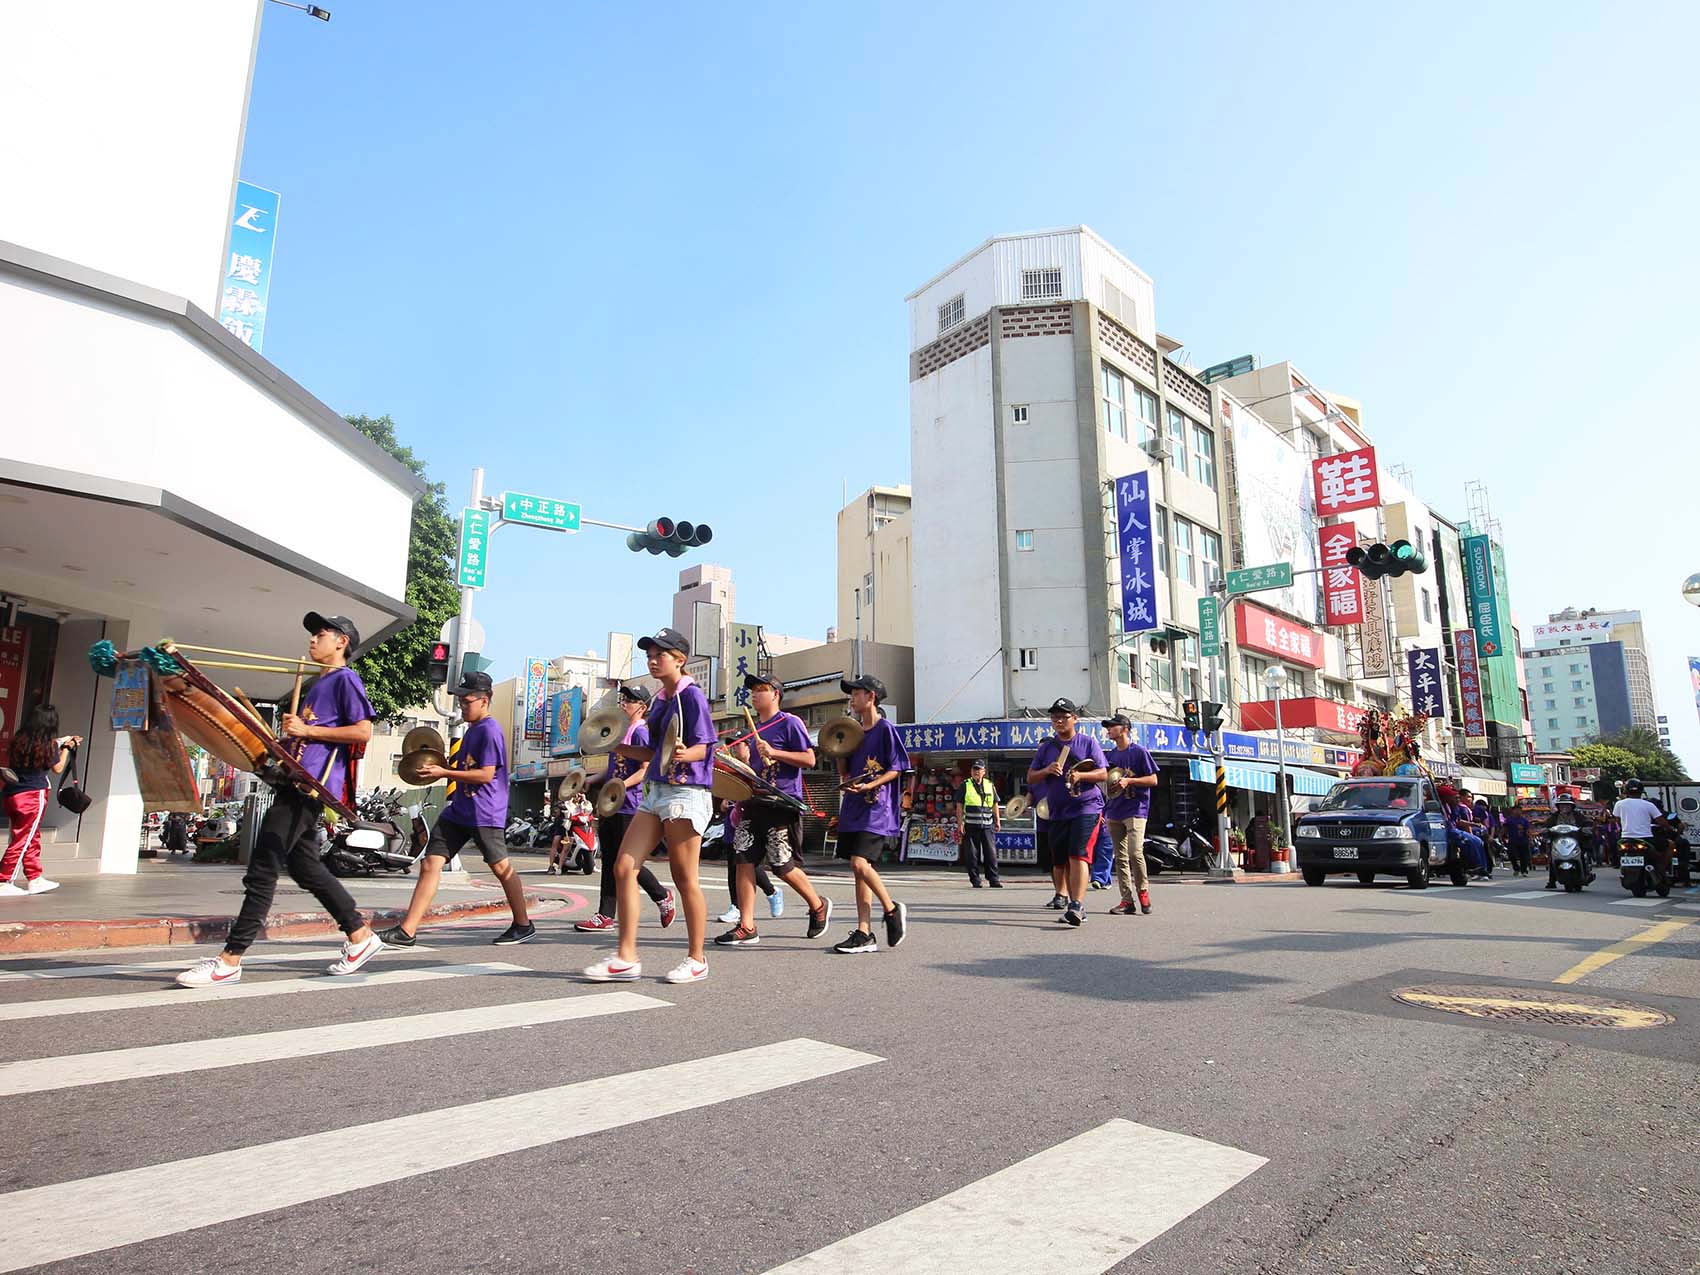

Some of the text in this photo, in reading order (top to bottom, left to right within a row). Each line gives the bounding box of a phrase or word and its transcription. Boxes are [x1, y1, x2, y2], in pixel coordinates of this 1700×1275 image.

[1317, 454, 1375, 508] 鞋
[520, 498, 566, 517] 中正路
[466, 521, 483, 566] 仁愛路
[1119, 479, 1153, 623] 仙人掌冰城
[1239, 567, 1277, 583] 仁愛路
[1323, 533, 1358, 617] 全家福
[1475, 546, 1486, 591] watsons
[1202, 607, 1215, 641] 中正路
[1264, 617, 1311, 658] 鞋全家福
[733, 628, 753, 709] 小天使
[1414, 650, 1440, 717] 太平洋
[954, 725, 1001, 746] 仙人掌汁
